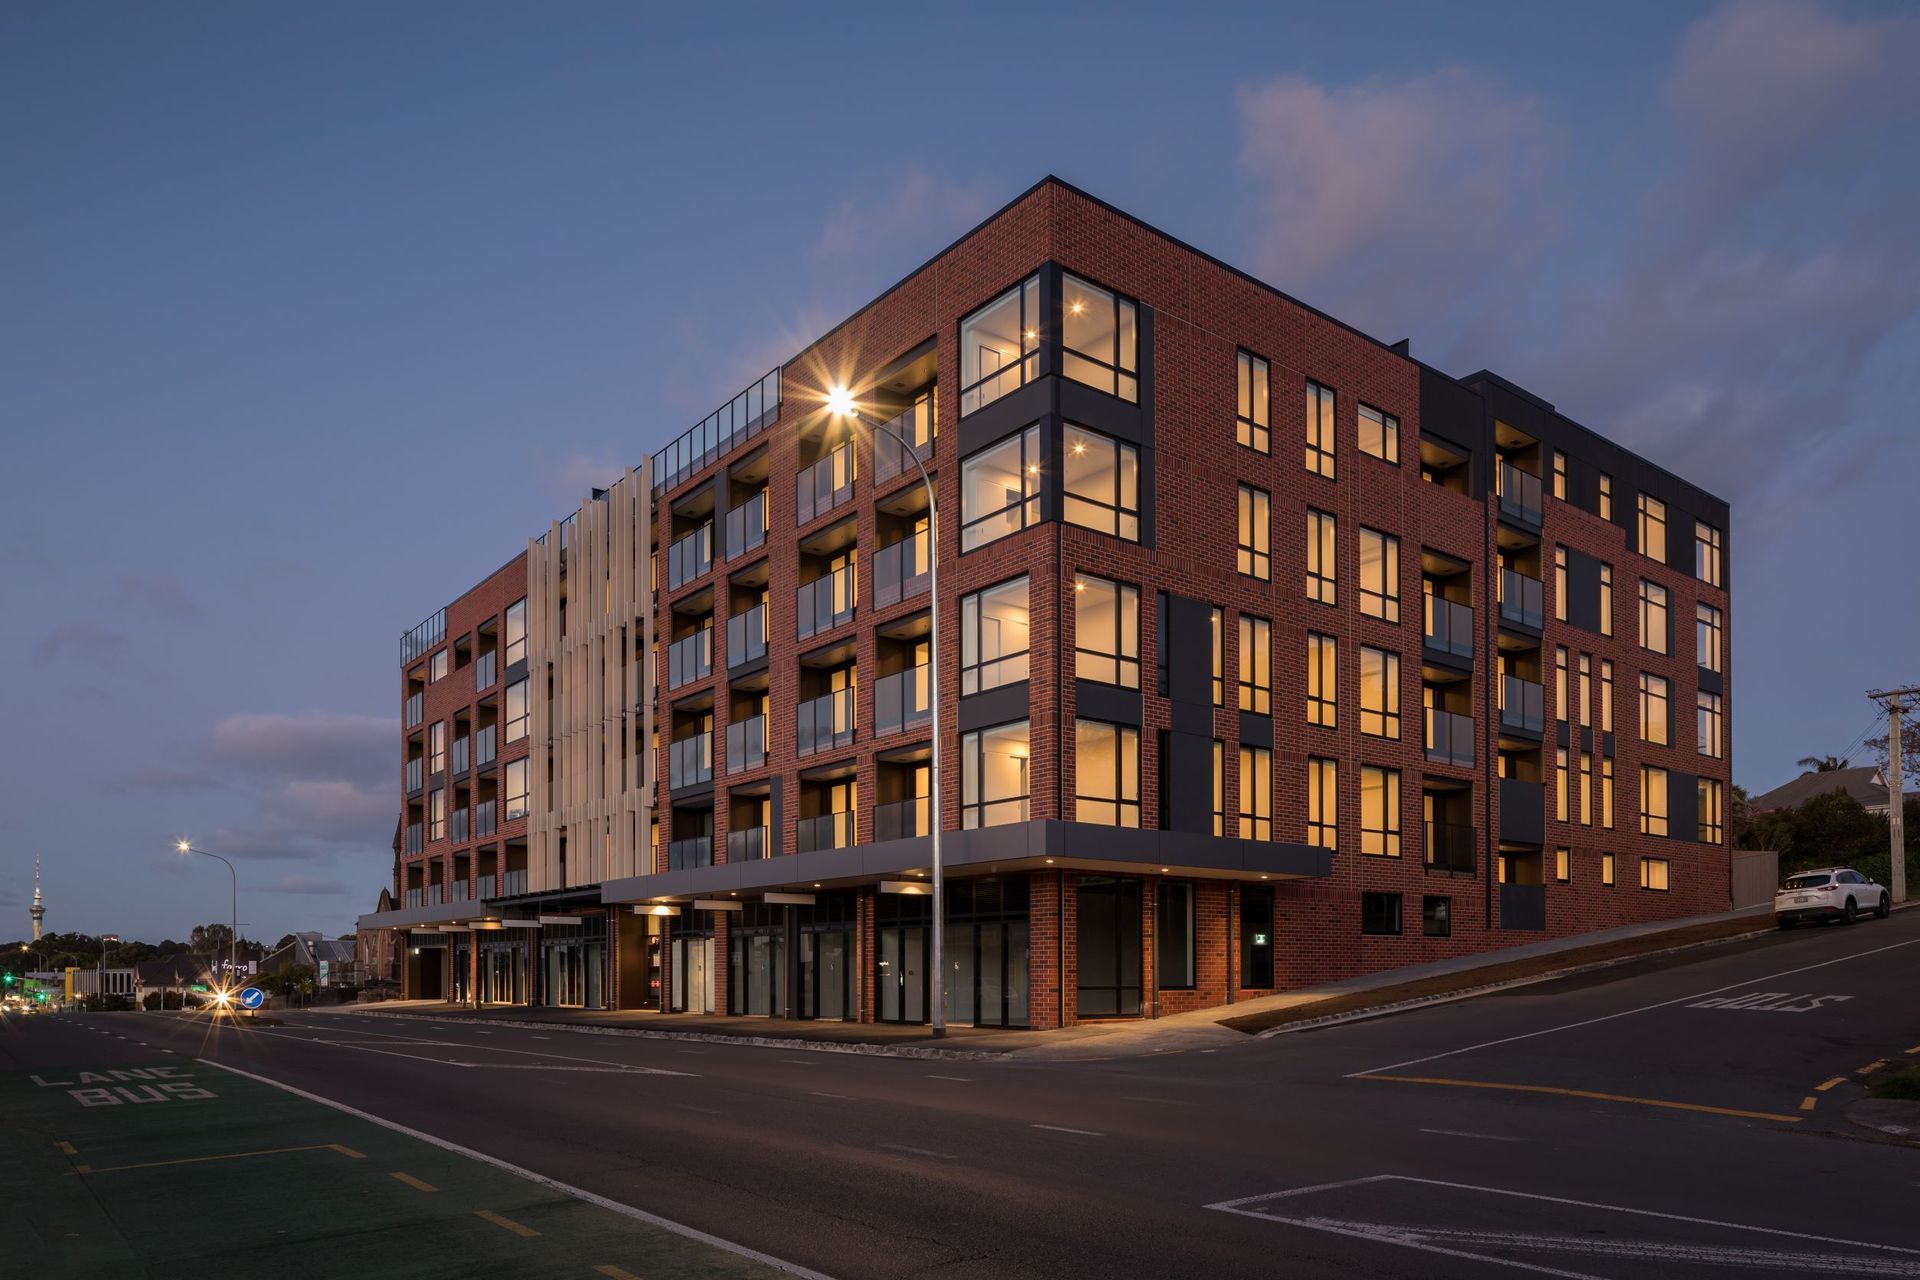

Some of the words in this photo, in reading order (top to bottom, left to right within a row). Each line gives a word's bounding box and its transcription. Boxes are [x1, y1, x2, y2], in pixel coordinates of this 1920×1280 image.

[221, 959, 248, 971] faro
[1684, 992, 1856, 1012] STOP
[30, 1066, 195, 1087] LANE
[66, 1082, 219, 1107] BUS
